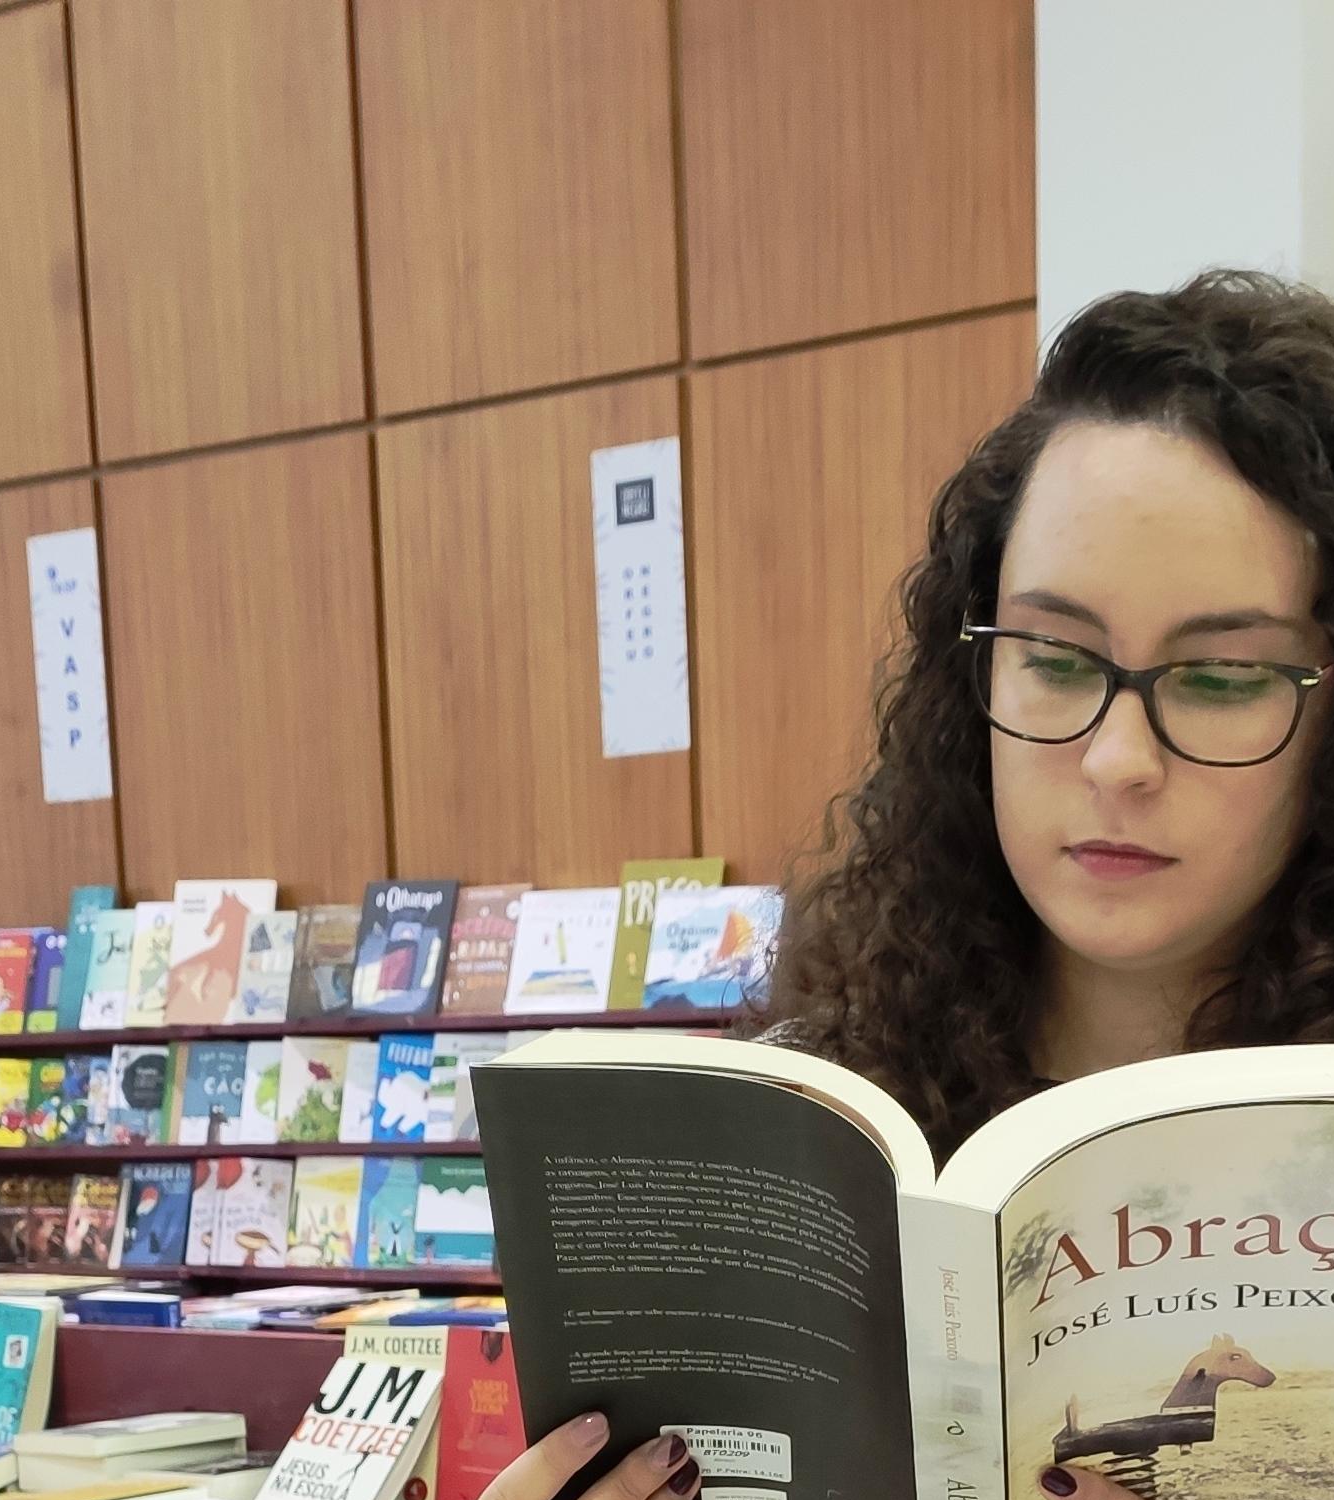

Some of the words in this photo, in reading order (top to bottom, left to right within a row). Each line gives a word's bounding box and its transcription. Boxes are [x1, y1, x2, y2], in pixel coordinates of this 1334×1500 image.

[60, 618, 83, 749] VASP
[939, 1266, 957, 1291] José
[941, 1294, 959, 1320] Luís
[1027, 1302, 1111, 1366] JOSÉ
[1125, 1288, 1217, 1319] LUÍS
[350, 1337, 379, 1354] J.M.
[384, 1337, 442, 1357] COETZEE
[943, 1322, 959, 1361] Peixoto
[313, 1362, 425, 1426] J.M.
[292, 1416, 412, 1456] COETZEE
[686, 1427, 743, 1437] Papelaria
[280, 1456, 330, 1477] JESUS
[270, 1474, 291, 1491] NA
